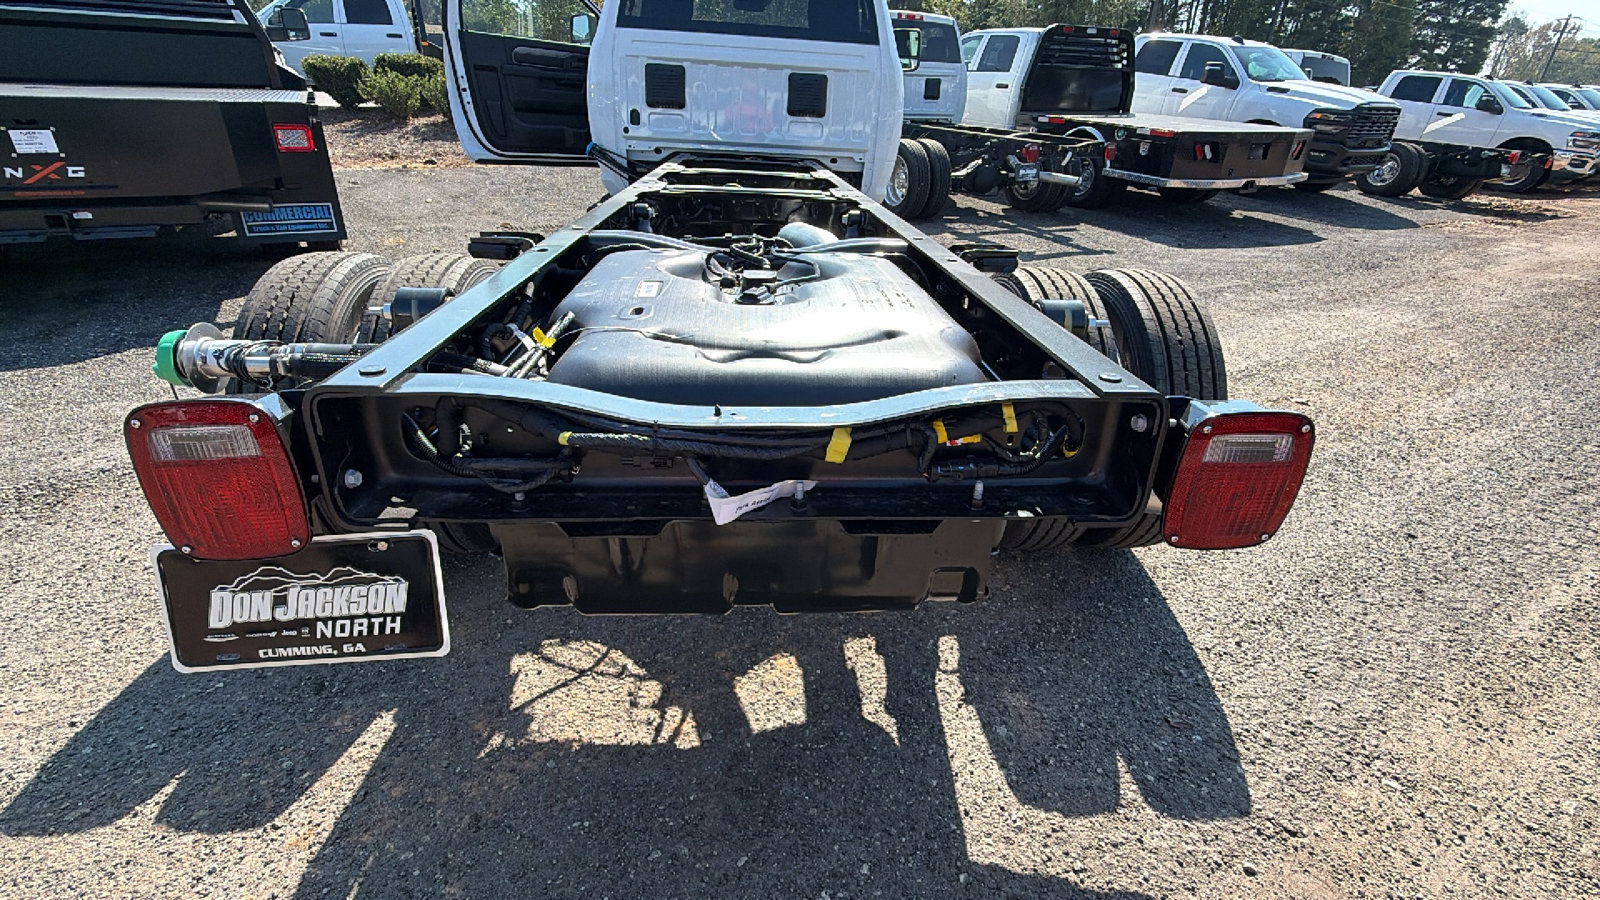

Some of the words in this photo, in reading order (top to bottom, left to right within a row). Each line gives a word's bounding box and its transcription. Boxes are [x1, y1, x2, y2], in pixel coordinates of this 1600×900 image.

[208, 590, 272, 629] DON
[273, 582, 408, 621] JACKSON
[316, 617, 401, 639] NORTH
[258, 644, 338, 659] CUMMING,
[343, 642, 366, 653] GA
